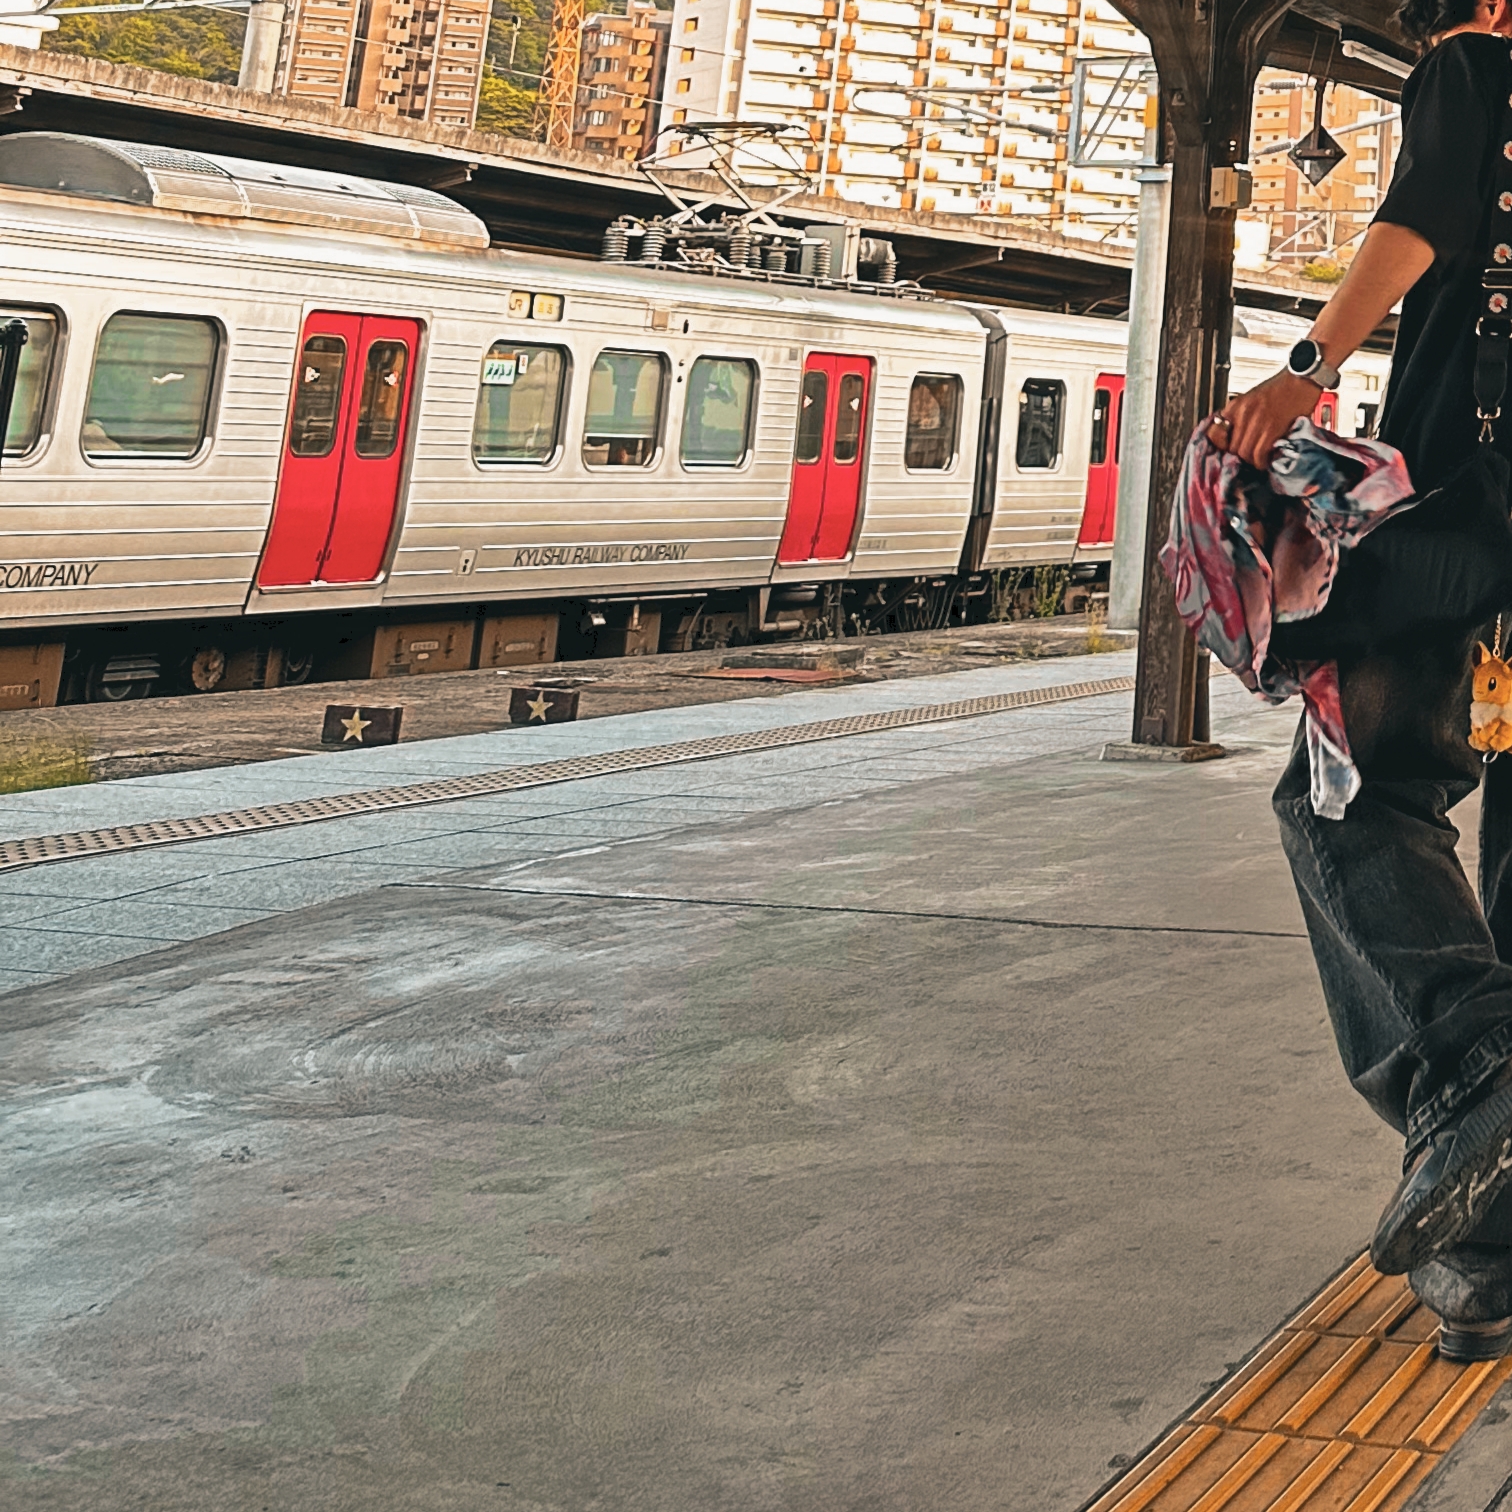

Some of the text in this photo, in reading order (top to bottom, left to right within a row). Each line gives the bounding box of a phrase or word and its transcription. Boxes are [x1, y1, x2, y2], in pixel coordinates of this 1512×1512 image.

[513, 544, 690, 567] KYUSHU RAILWAY COMPANY
